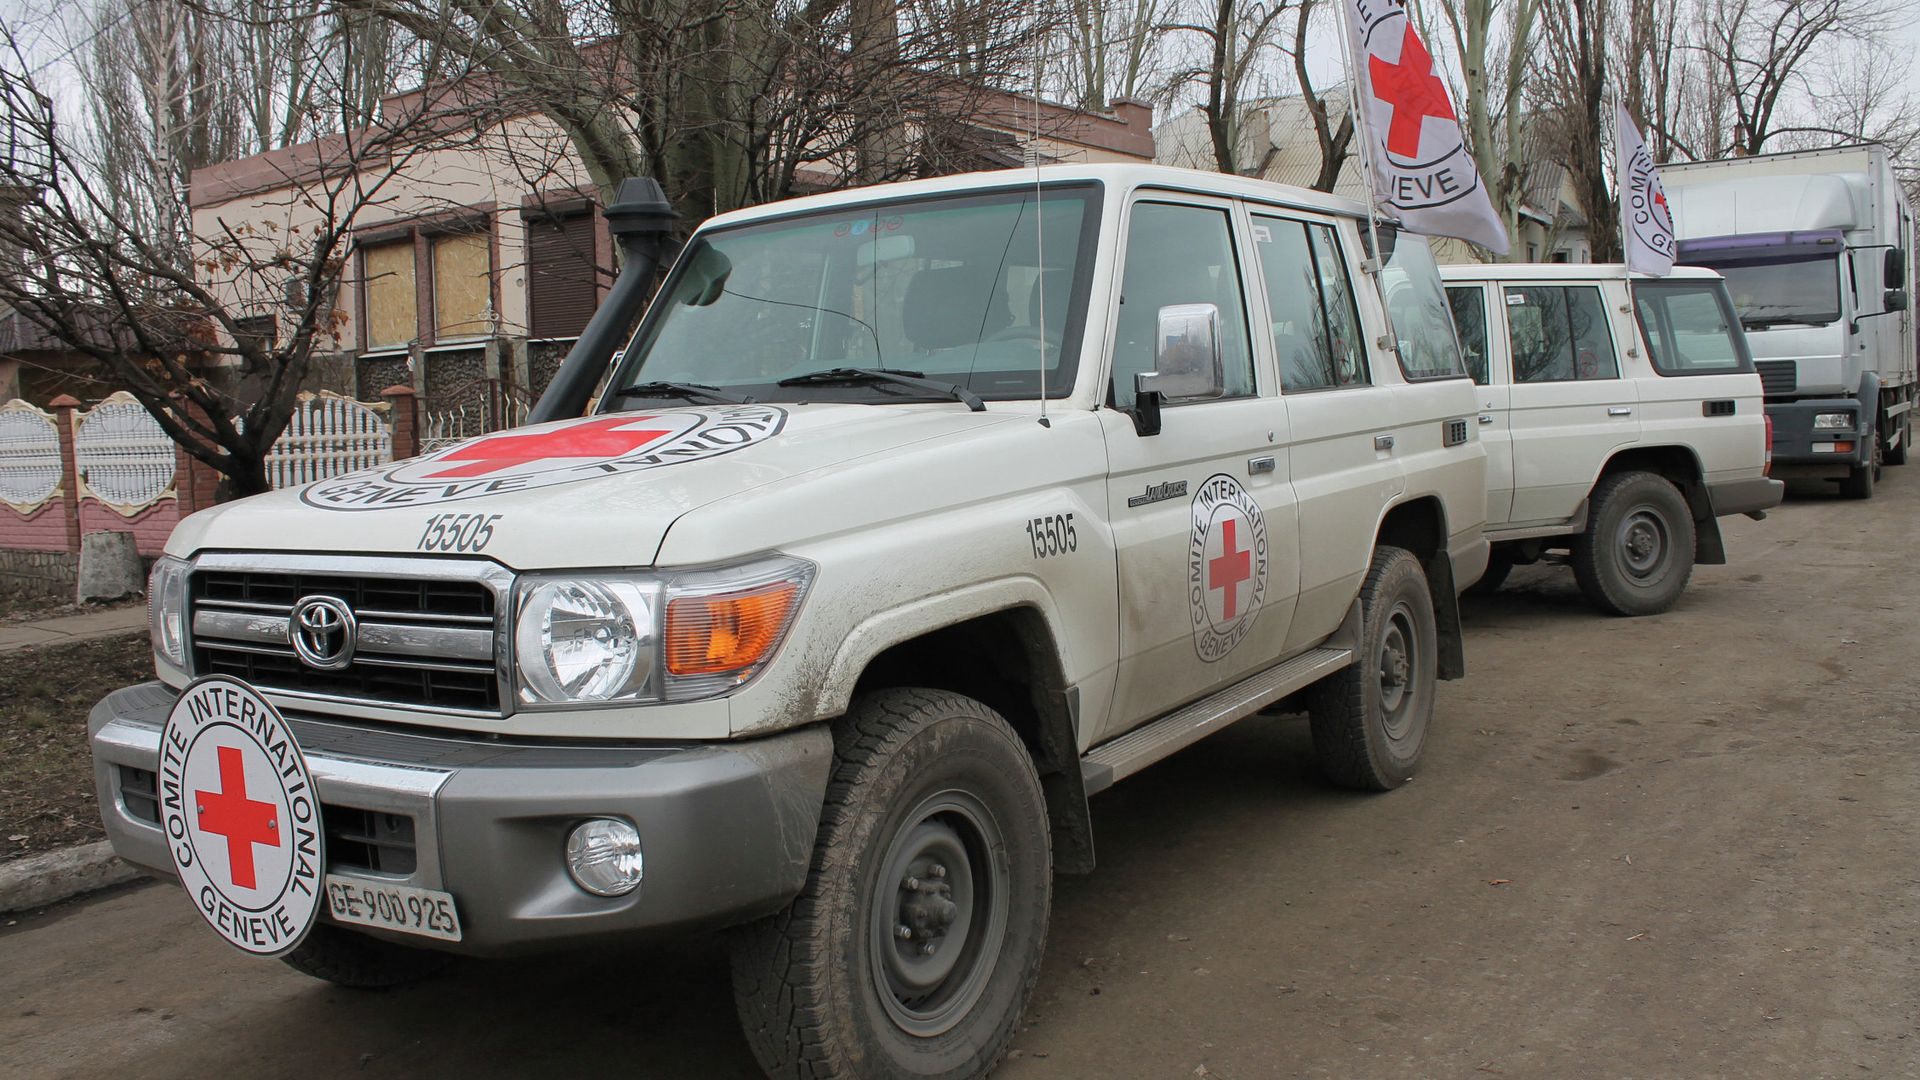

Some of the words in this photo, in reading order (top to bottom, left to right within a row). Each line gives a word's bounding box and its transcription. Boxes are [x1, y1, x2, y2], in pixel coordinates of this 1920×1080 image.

[1391, 168, 1459, 200] EVE
[318, 475, 534, 504] GENEVE
[417, 513, 503, 552] 15505
[1026, 513, 1078, 559] 15505
[1191, 516, 1207, 625] COMITE
[1200, 480, 1266, 607] INTERNATIONAL
[1200, 617, 1247, 657] GENEVE
[162, 722, 193, 868] COMITE
[187, 687, 317, 898] INTERNATIONAL
[200, 885, 296, 946] GENEVE
